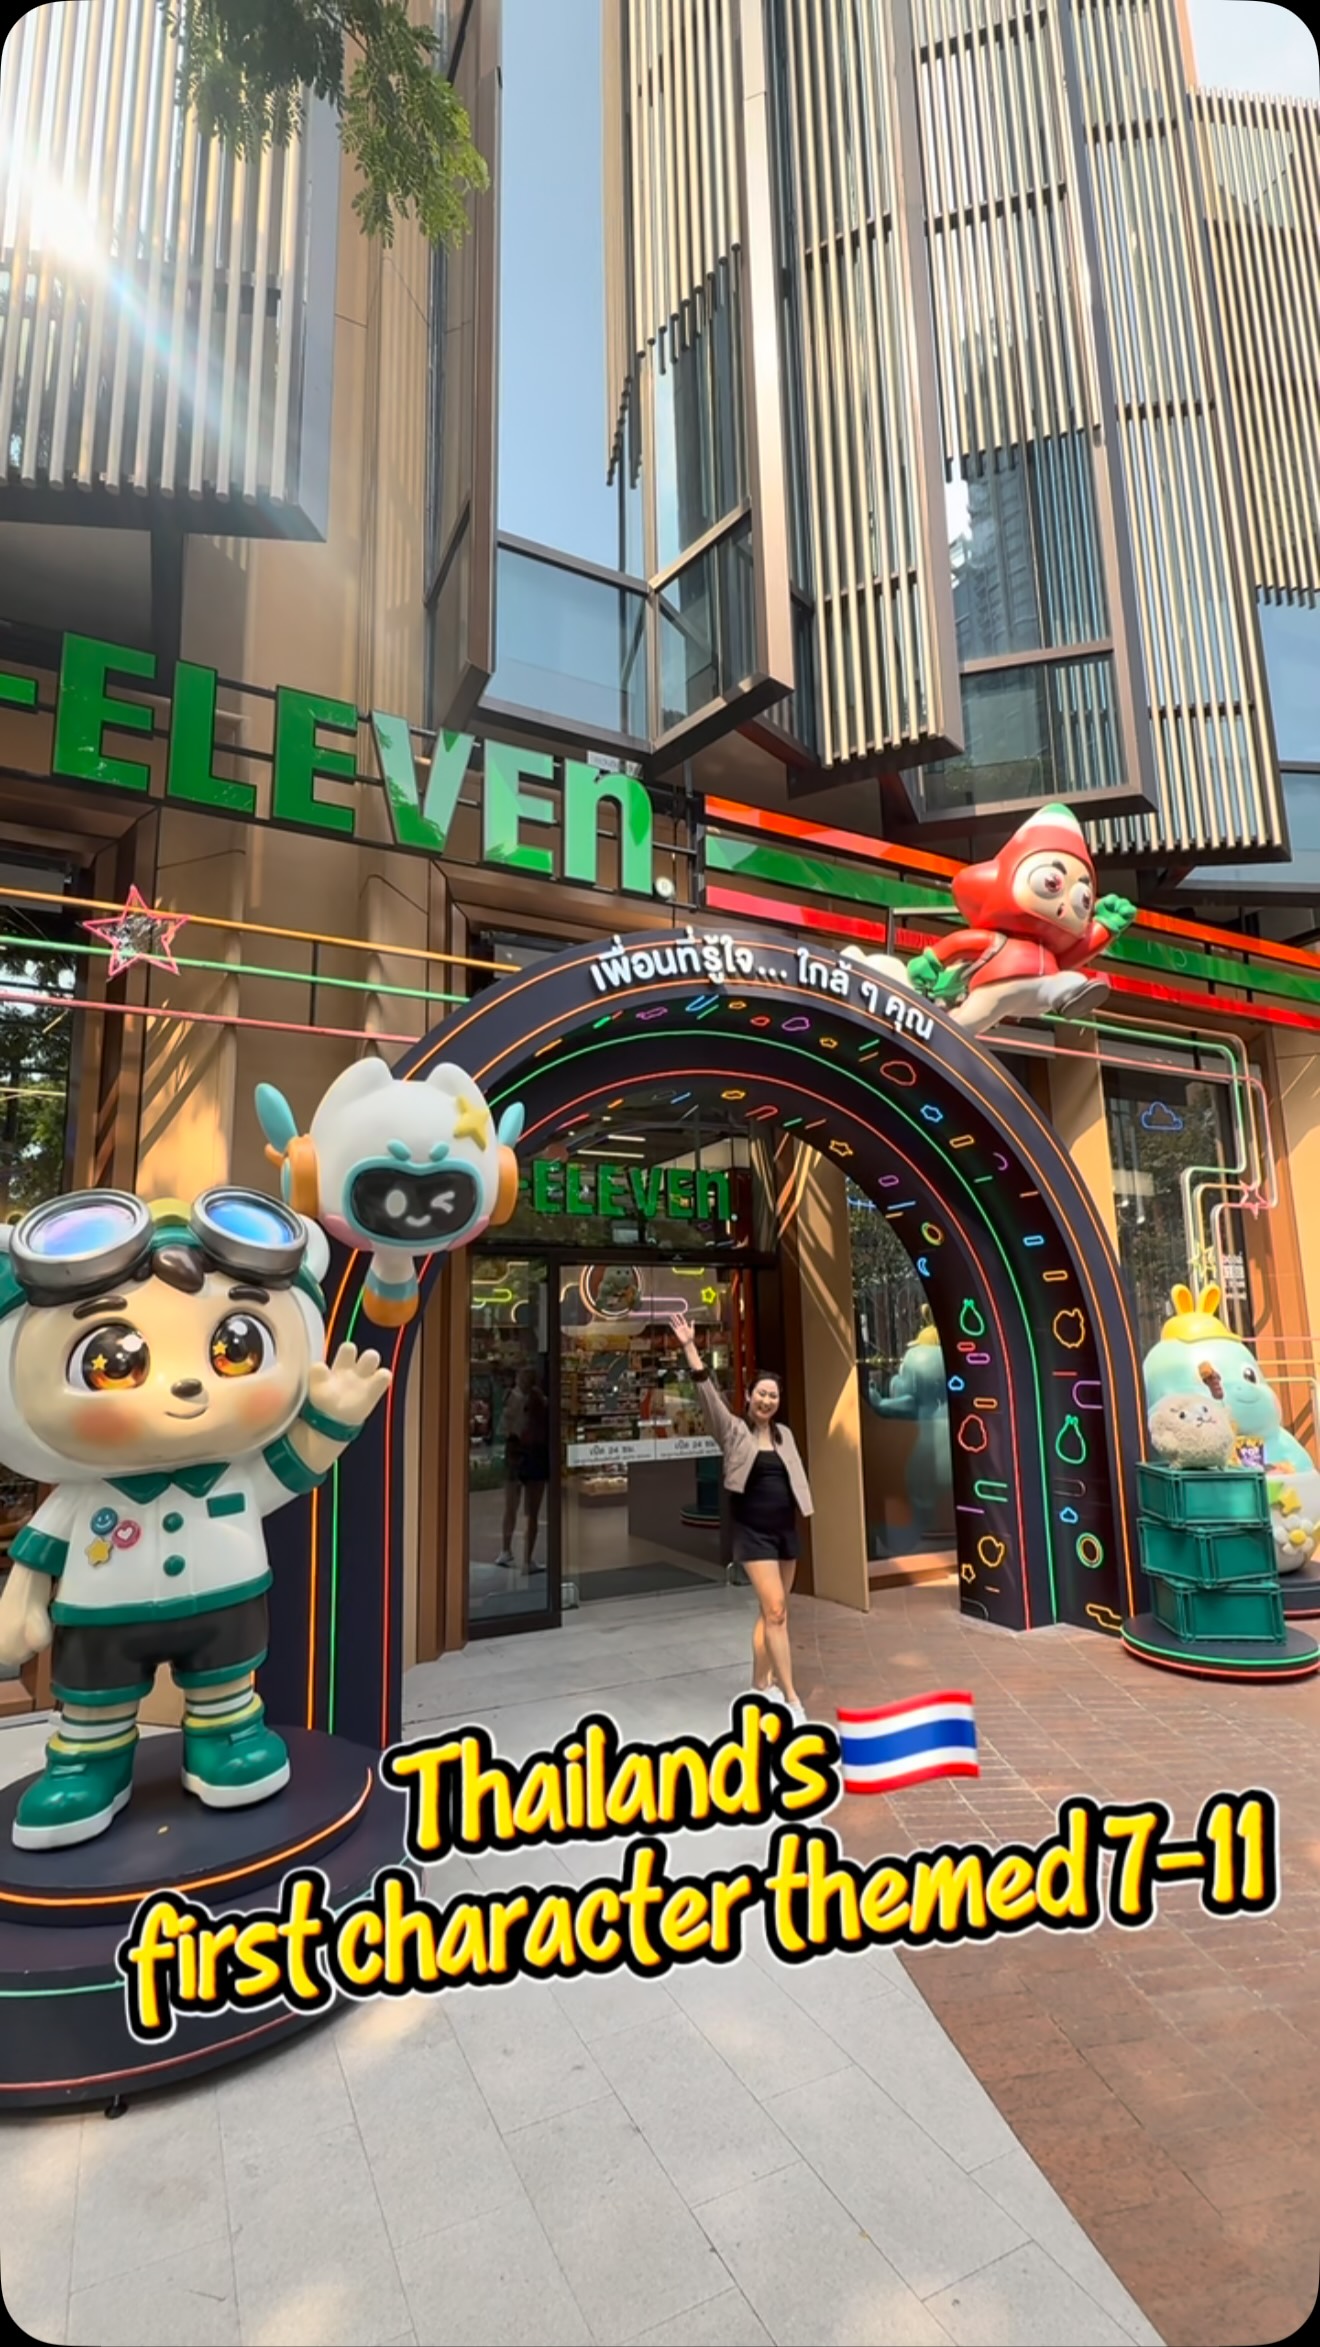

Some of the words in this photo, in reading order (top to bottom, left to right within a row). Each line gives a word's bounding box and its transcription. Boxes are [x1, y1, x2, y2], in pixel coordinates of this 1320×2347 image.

[590, 926, 788, 992] เพื่อนที่รู้ใจ...
[797, 946, 851, 997] ใกล้
[861, 980, 879, 1014] ๆ
[885, 995, 935, 1041] คุณ
